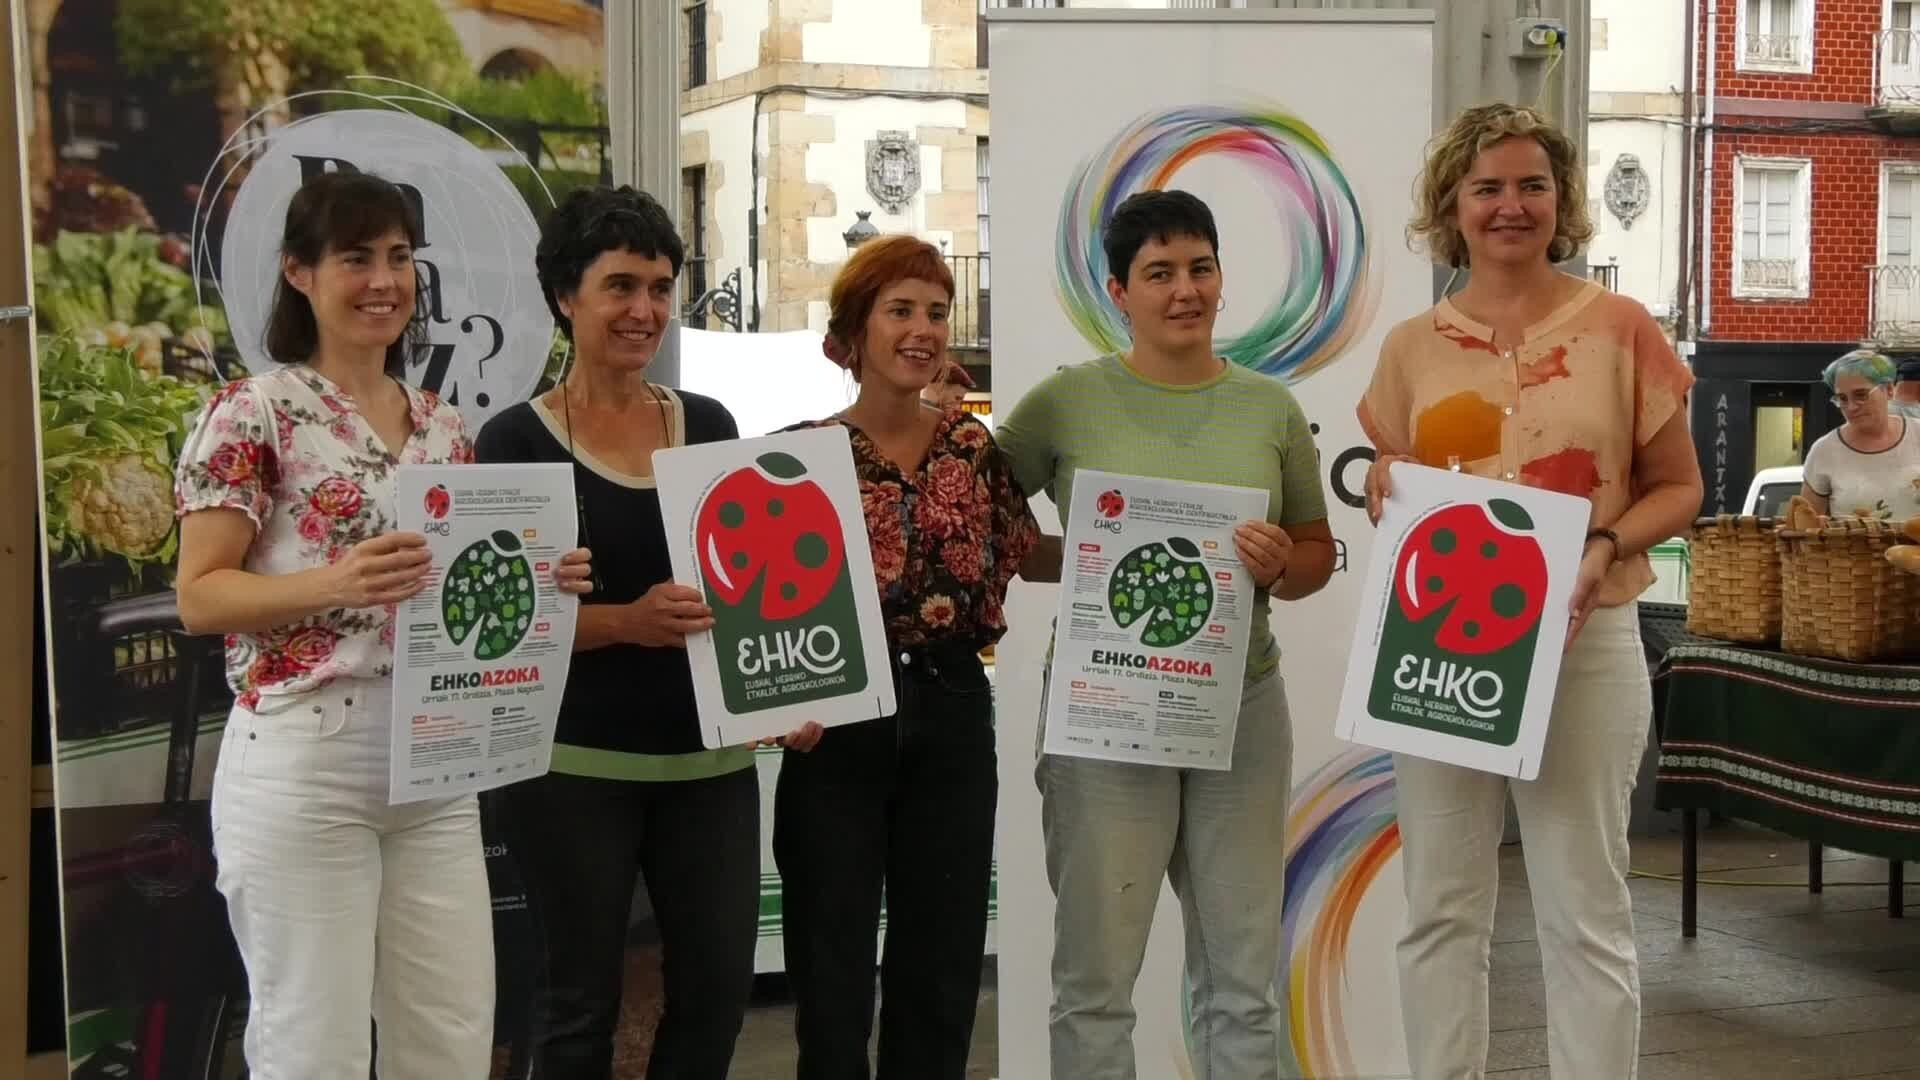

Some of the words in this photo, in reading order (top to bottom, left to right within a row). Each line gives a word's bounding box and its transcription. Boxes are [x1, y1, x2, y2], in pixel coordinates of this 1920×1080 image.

[738, 625, 846, 674] EHKO
[1082, 664, 1111, 676] Urriak
[1161, 673, 1185, 684] Plaza
[1091, 649, 1213, 676] EHKOAZOKA
[431, 666, 539, 691] EHKOAZOKA
[1394, 654, 1503, 718] EHKO
[746, 686, 780, 701] ETXALDE
[1390, 702, 1424, 717] ETXALDE
